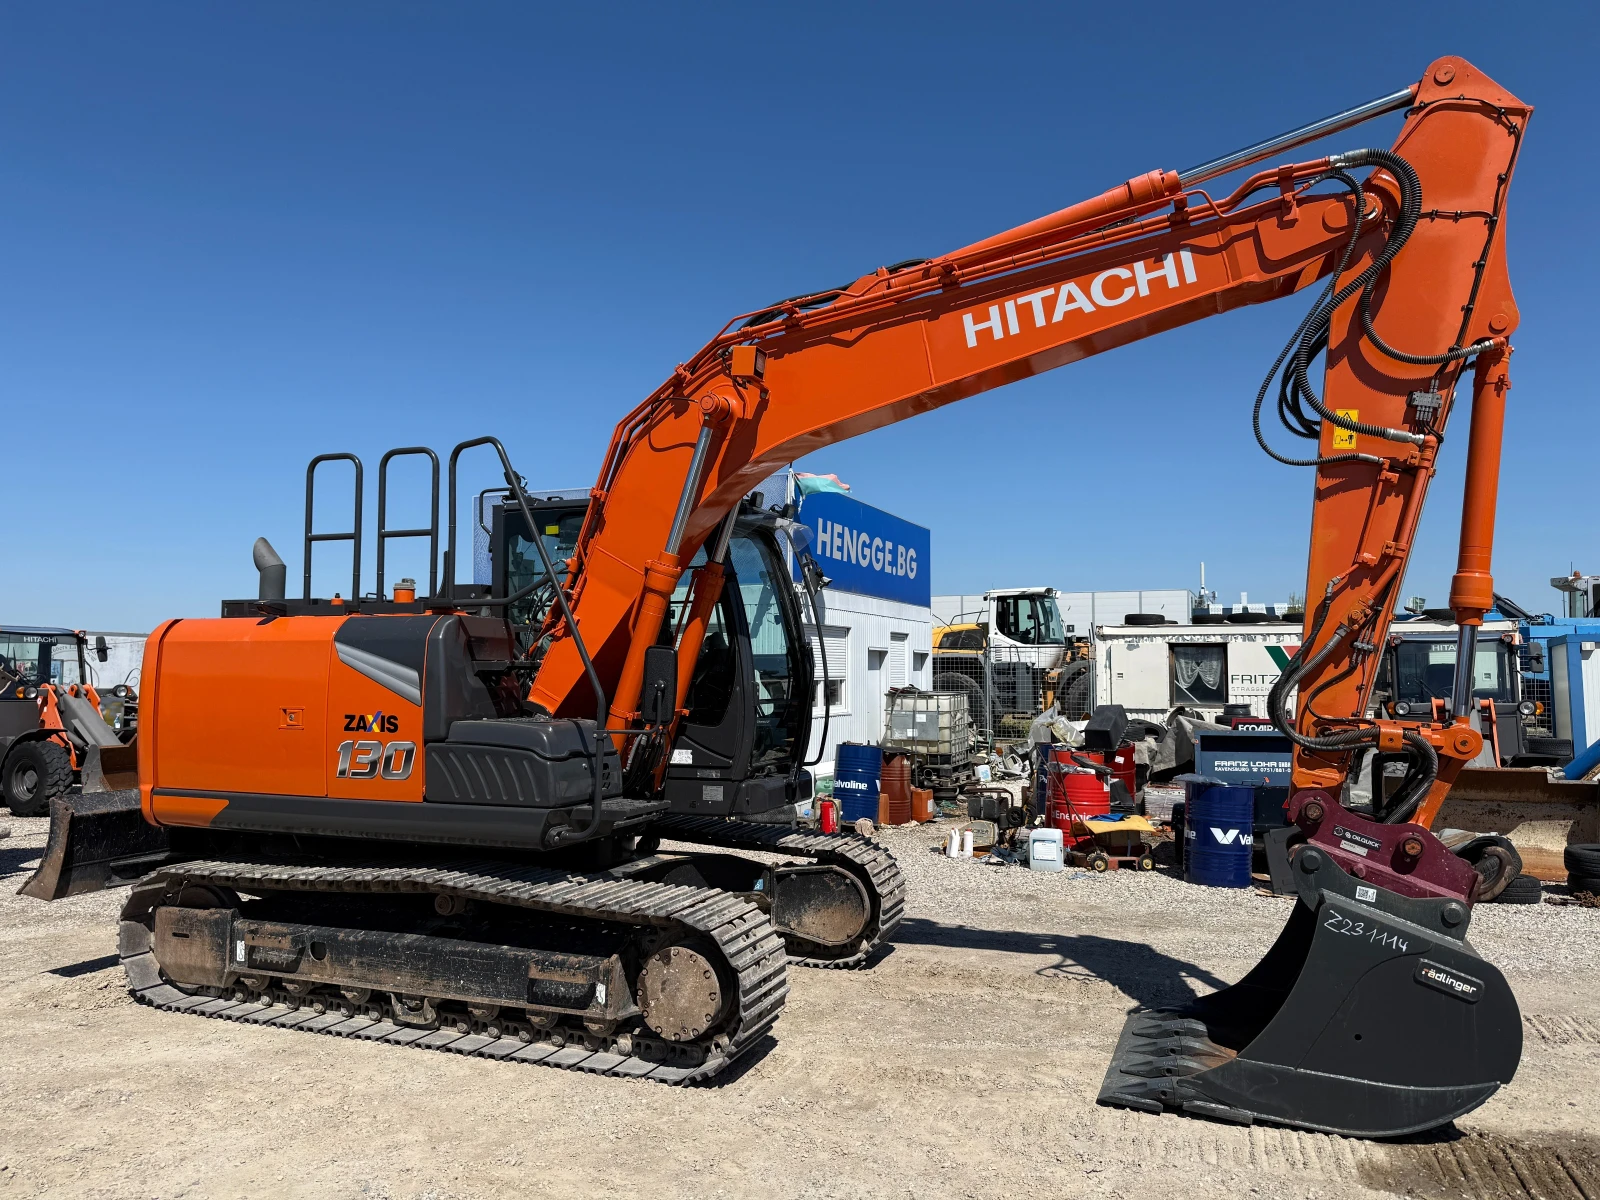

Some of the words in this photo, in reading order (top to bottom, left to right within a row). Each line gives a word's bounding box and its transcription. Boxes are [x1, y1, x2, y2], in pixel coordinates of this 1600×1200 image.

[962, 247, 1197, 349] HITACHI
[817, 517, 918, 580] HENGGE.BG
[1231, 674, 1280, 684] FRITZ
[344, 711, 398, 733] ZAXIS
[336, 740, 417, 780] 130
[1351, 834, 1380, 849] OILQUICK
